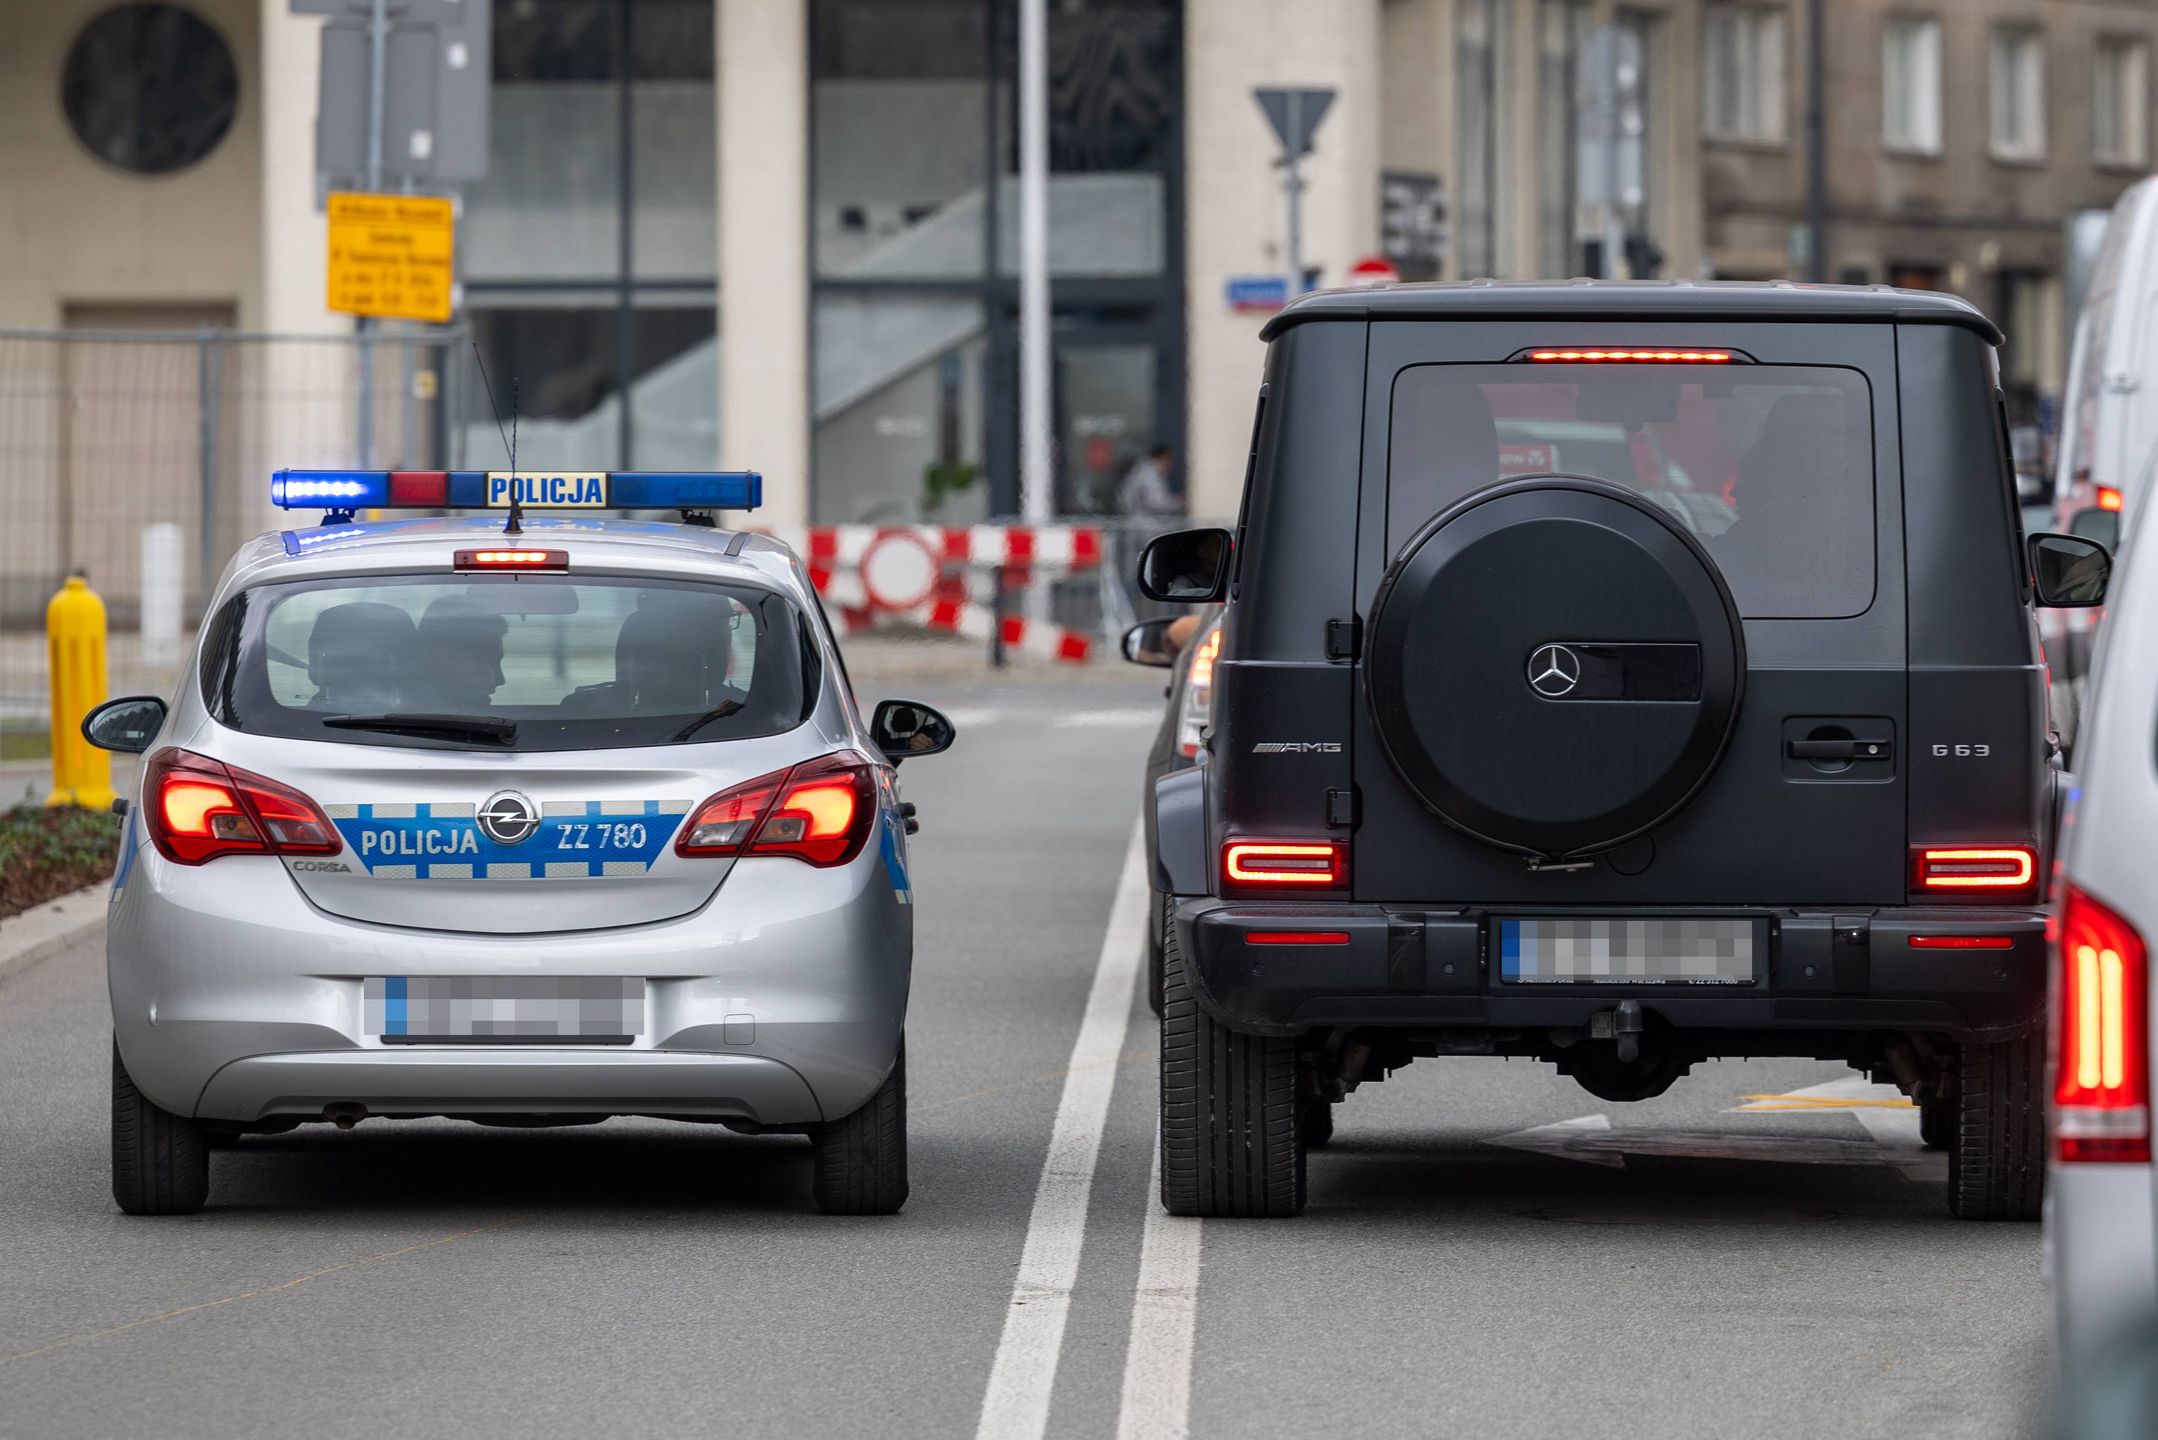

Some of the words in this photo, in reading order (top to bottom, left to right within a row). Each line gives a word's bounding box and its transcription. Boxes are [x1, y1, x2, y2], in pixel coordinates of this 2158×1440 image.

[491, 477, 603, 504] POLICJA
[1281, 742, 1342, 753] AMG
[1932, 744, 1948, 757] G
[1954, 744, 1990, 757] 63
[361, 829, 479, 856] POLICJA
[557, 824, 590, 849] ZZ
[596, 823, 647, 849] 780
[293, 860, 352, 873] CORSA
